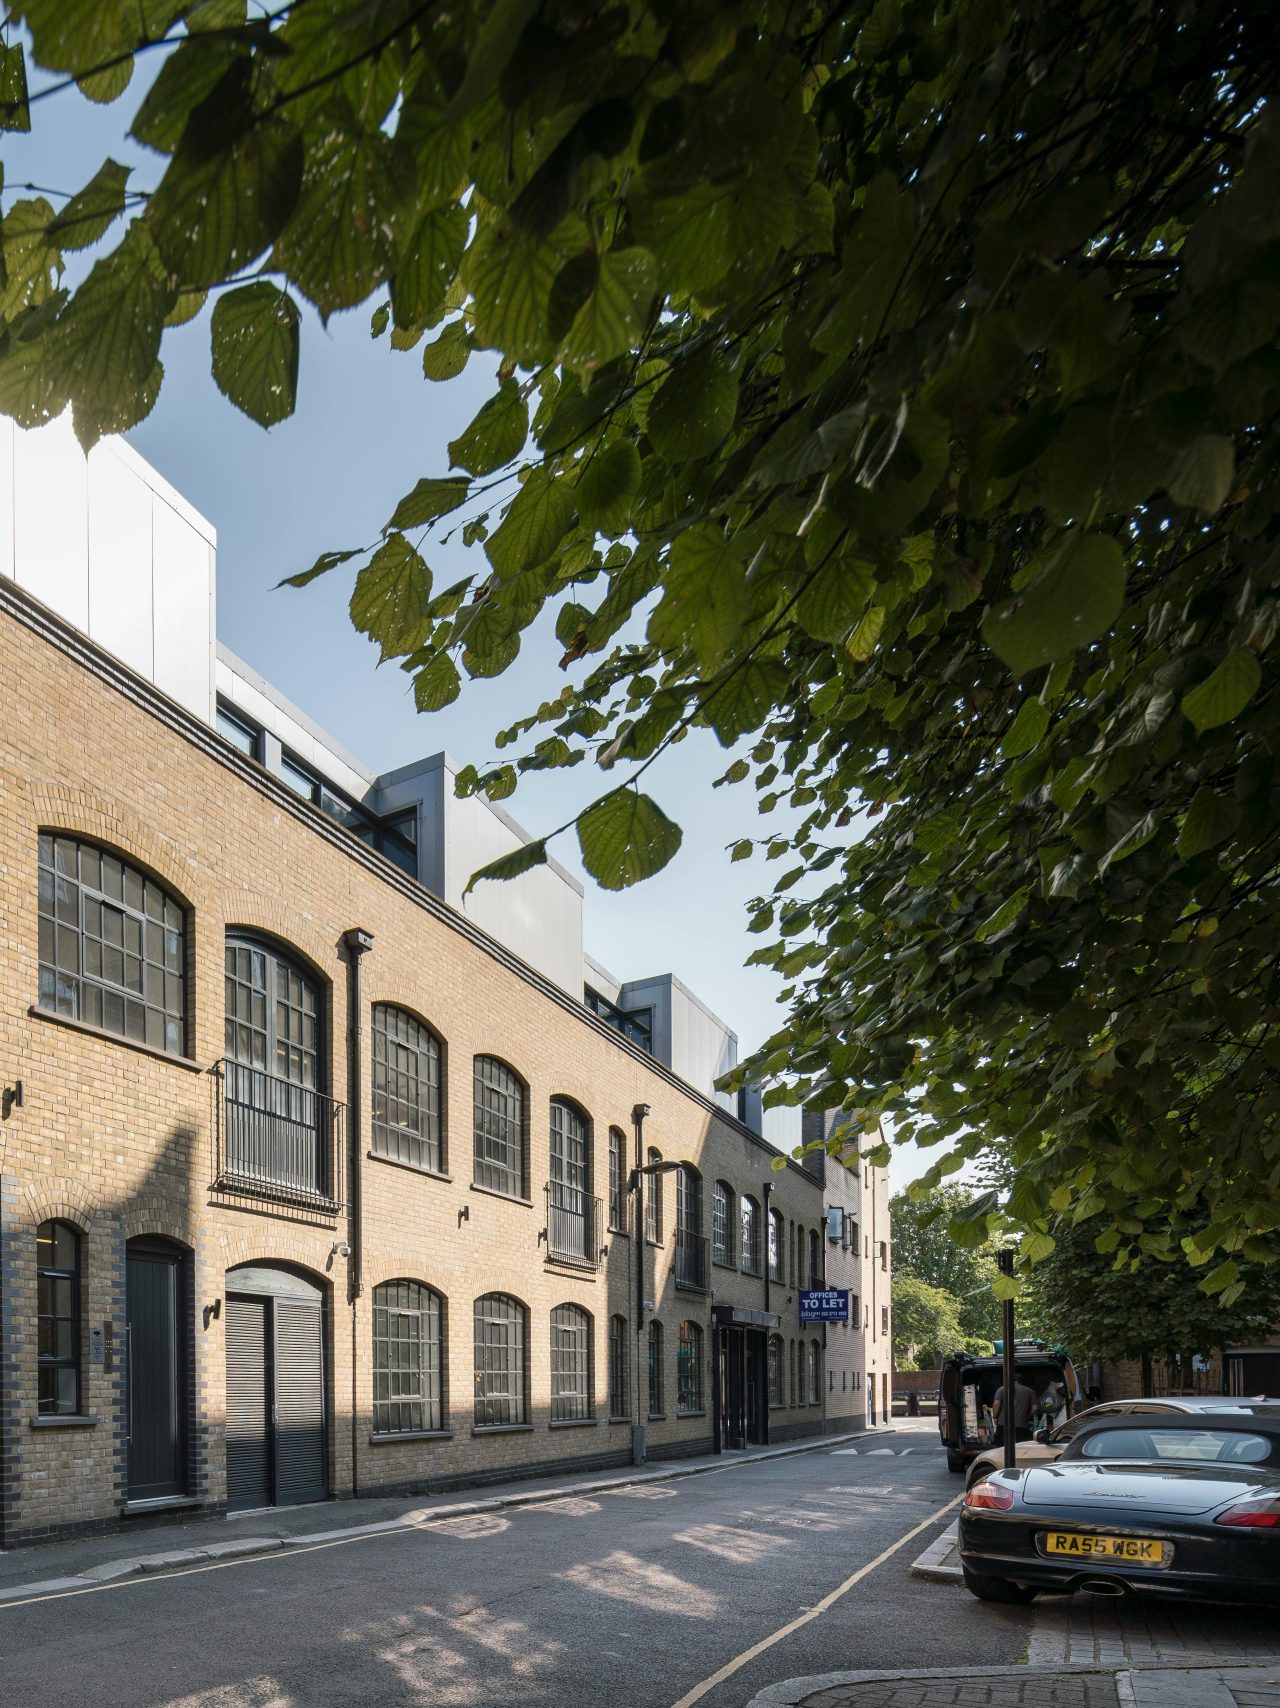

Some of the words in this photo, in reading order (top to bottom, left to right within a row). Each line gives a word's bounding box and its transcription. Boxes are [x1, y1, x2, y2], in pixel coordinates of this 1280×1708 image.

[802, 1299, 819, 1308] TO
[822, 1298, 845, 1308] LET
[1055, 1535, 1107, 1554] RA55
[1112, 1540, 1153, 1558] WGK
